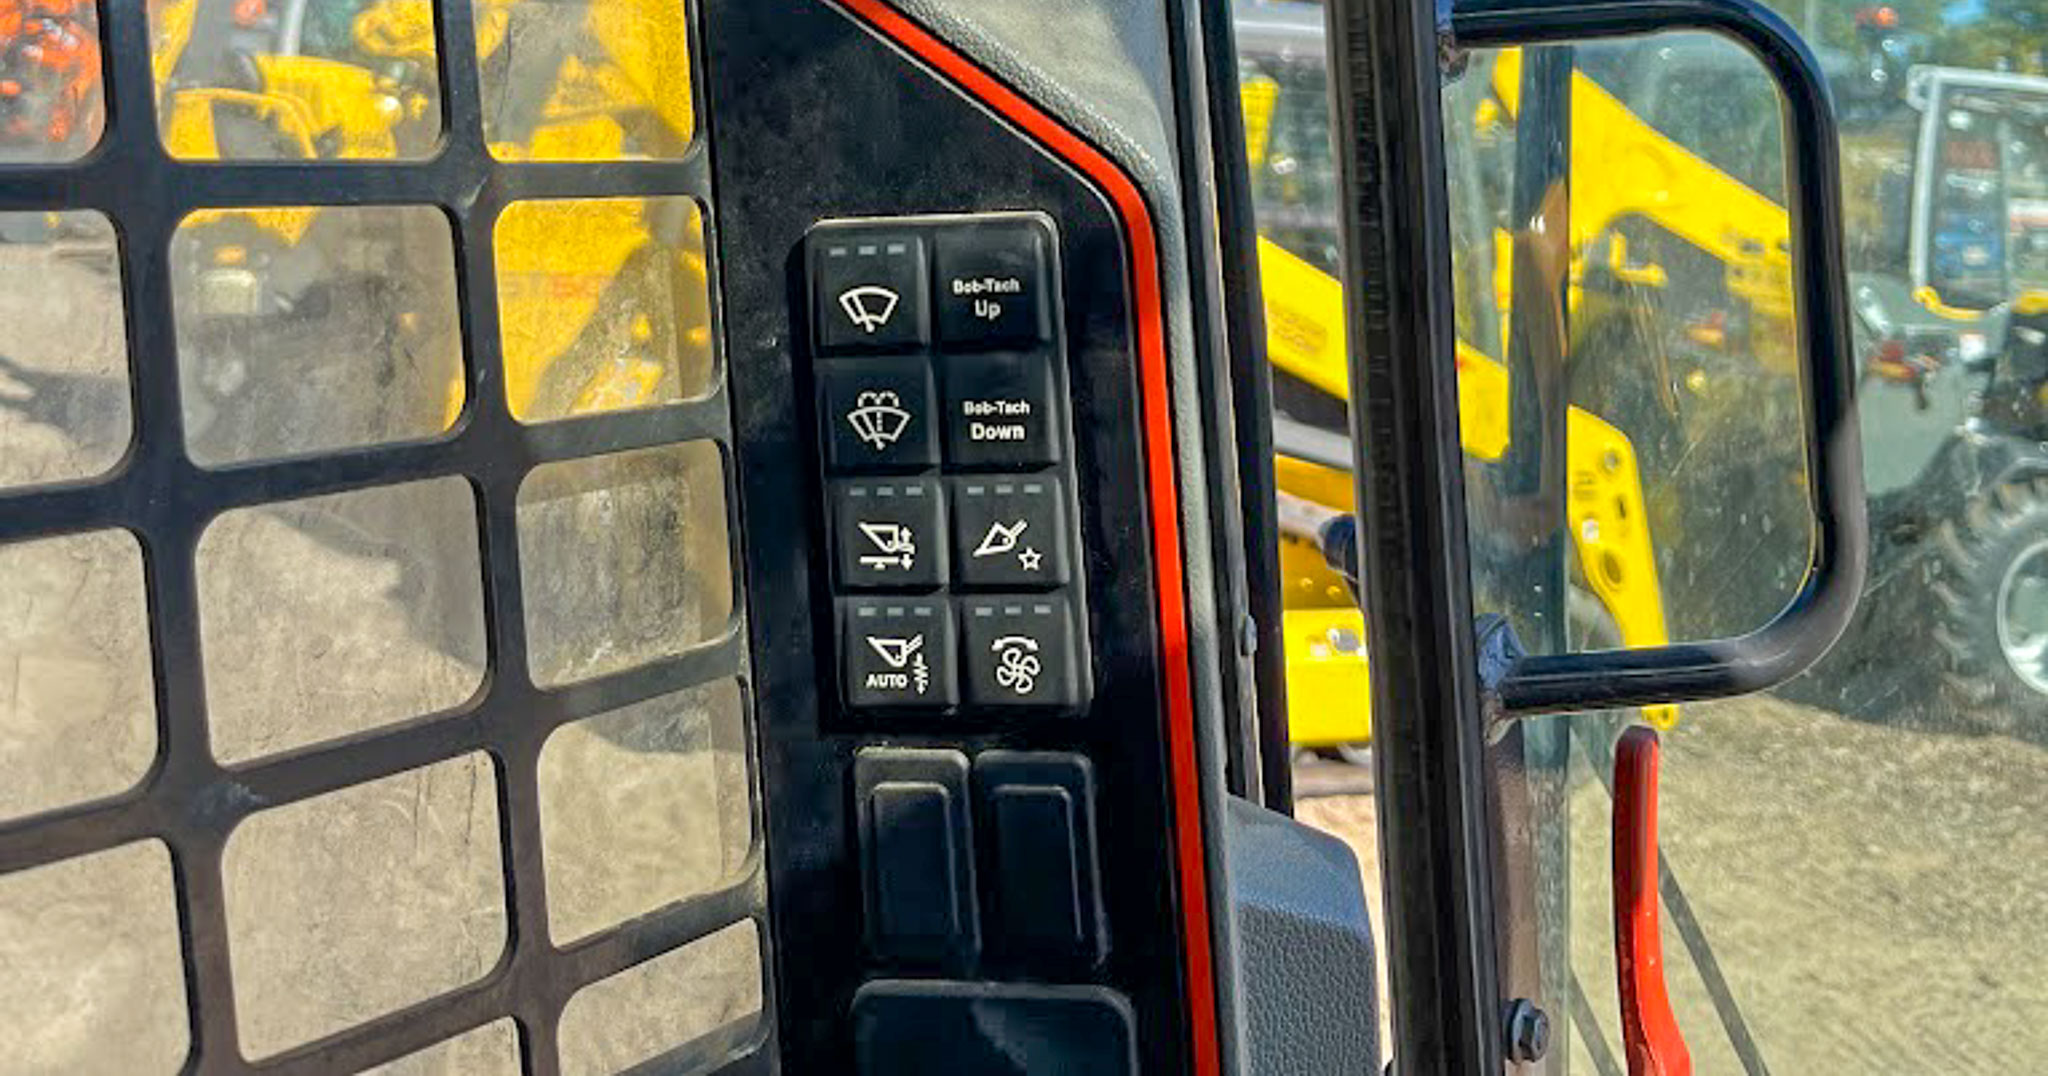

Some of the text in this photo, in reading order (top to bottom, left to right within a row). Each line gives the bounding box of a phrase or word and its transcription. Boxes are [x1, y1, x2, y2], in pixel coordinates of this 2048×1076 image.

[953, 277, 1020, 294] Bob-Tach
[974, 299, 1001, 320] Up
[963, 399, 1031, 415] Bob-Tach
[970, 422, 1025, 440] Down
[866, 673, 908, 689] AUTO
